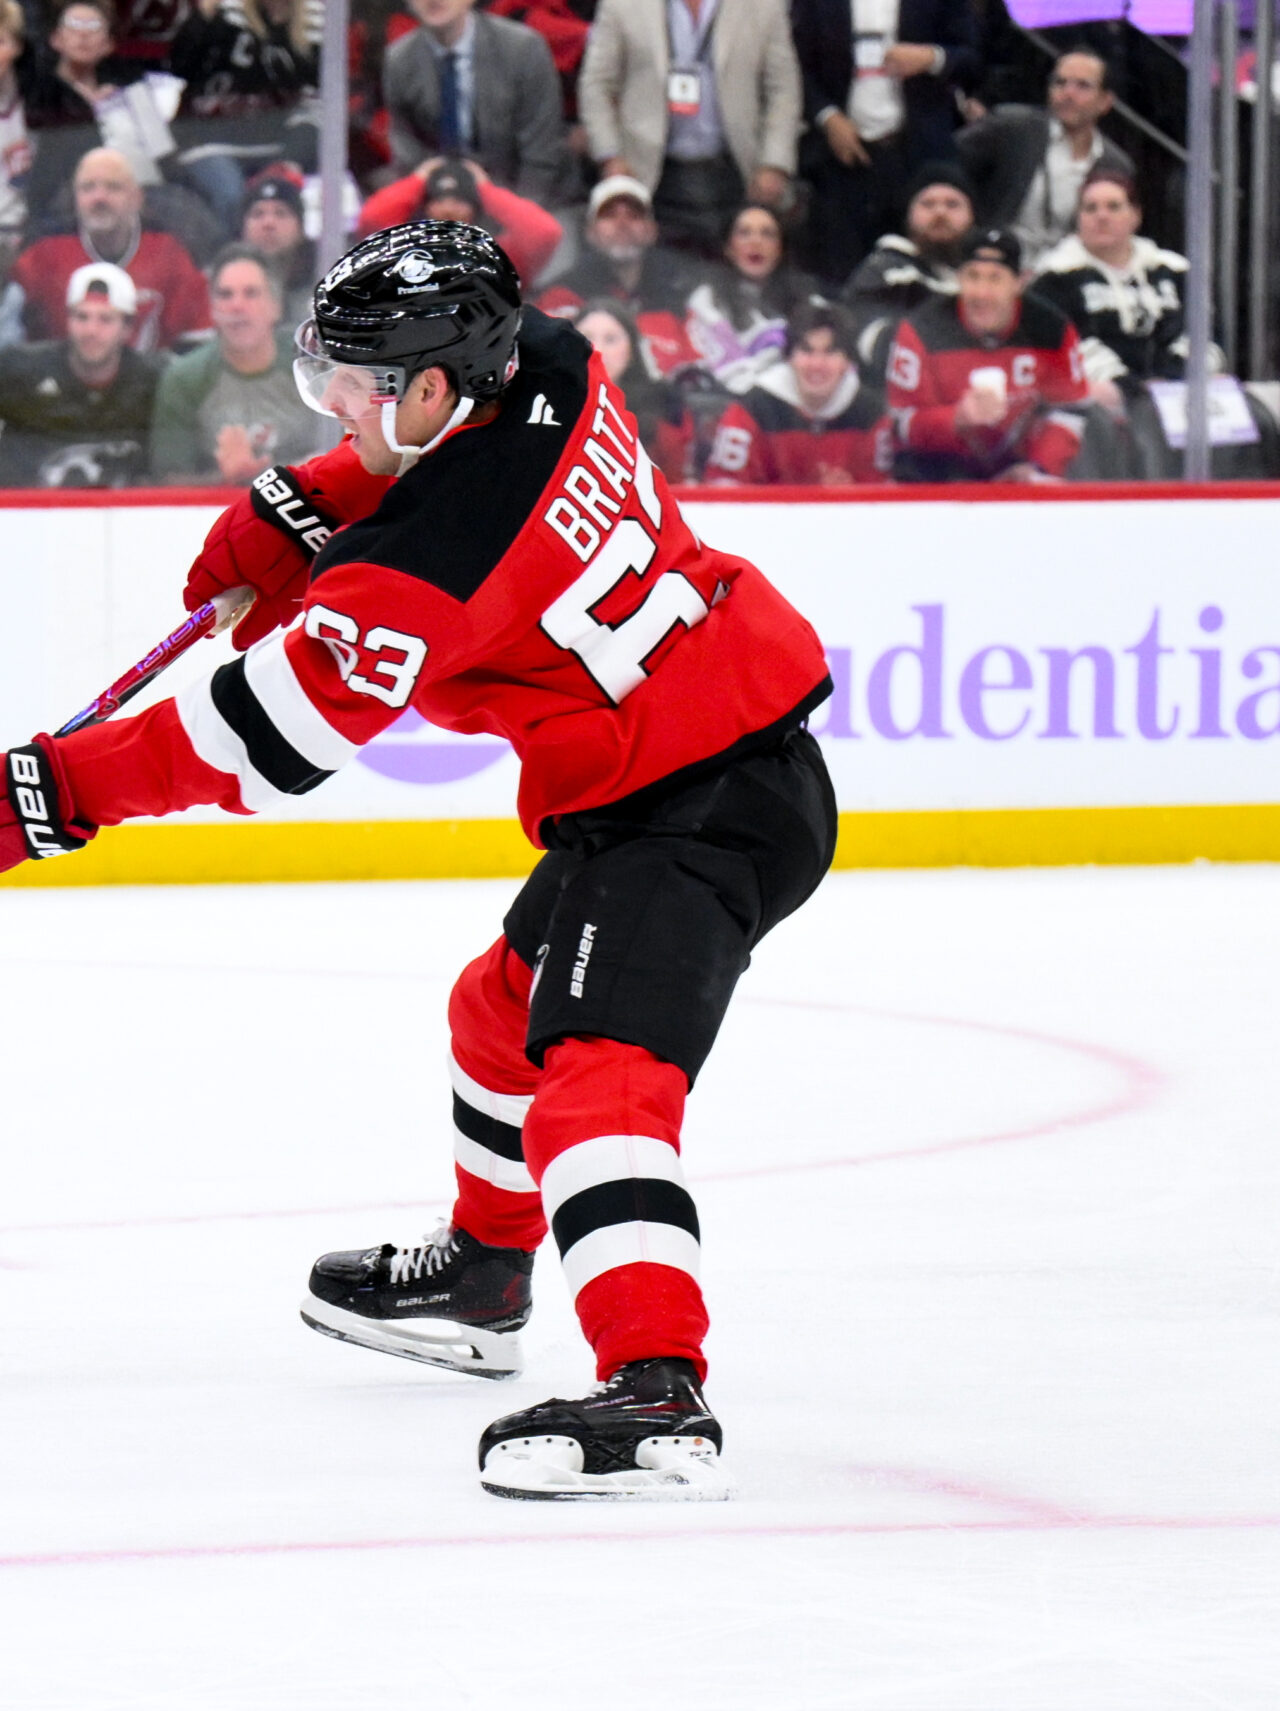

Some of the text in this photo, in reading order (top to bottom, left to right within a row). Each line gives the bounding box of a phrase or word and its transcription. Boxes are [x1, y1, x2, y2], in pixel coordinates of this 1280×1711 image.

[1012, 354, 1036, 387] C
[252, 467, 333, 553] BAUE
[543, 383, 635, 564] BRATT
[539, 438, 731, 707] 6
[9, 752, 70, 858] BAU
[569, 922, 598, 999] BAUER
